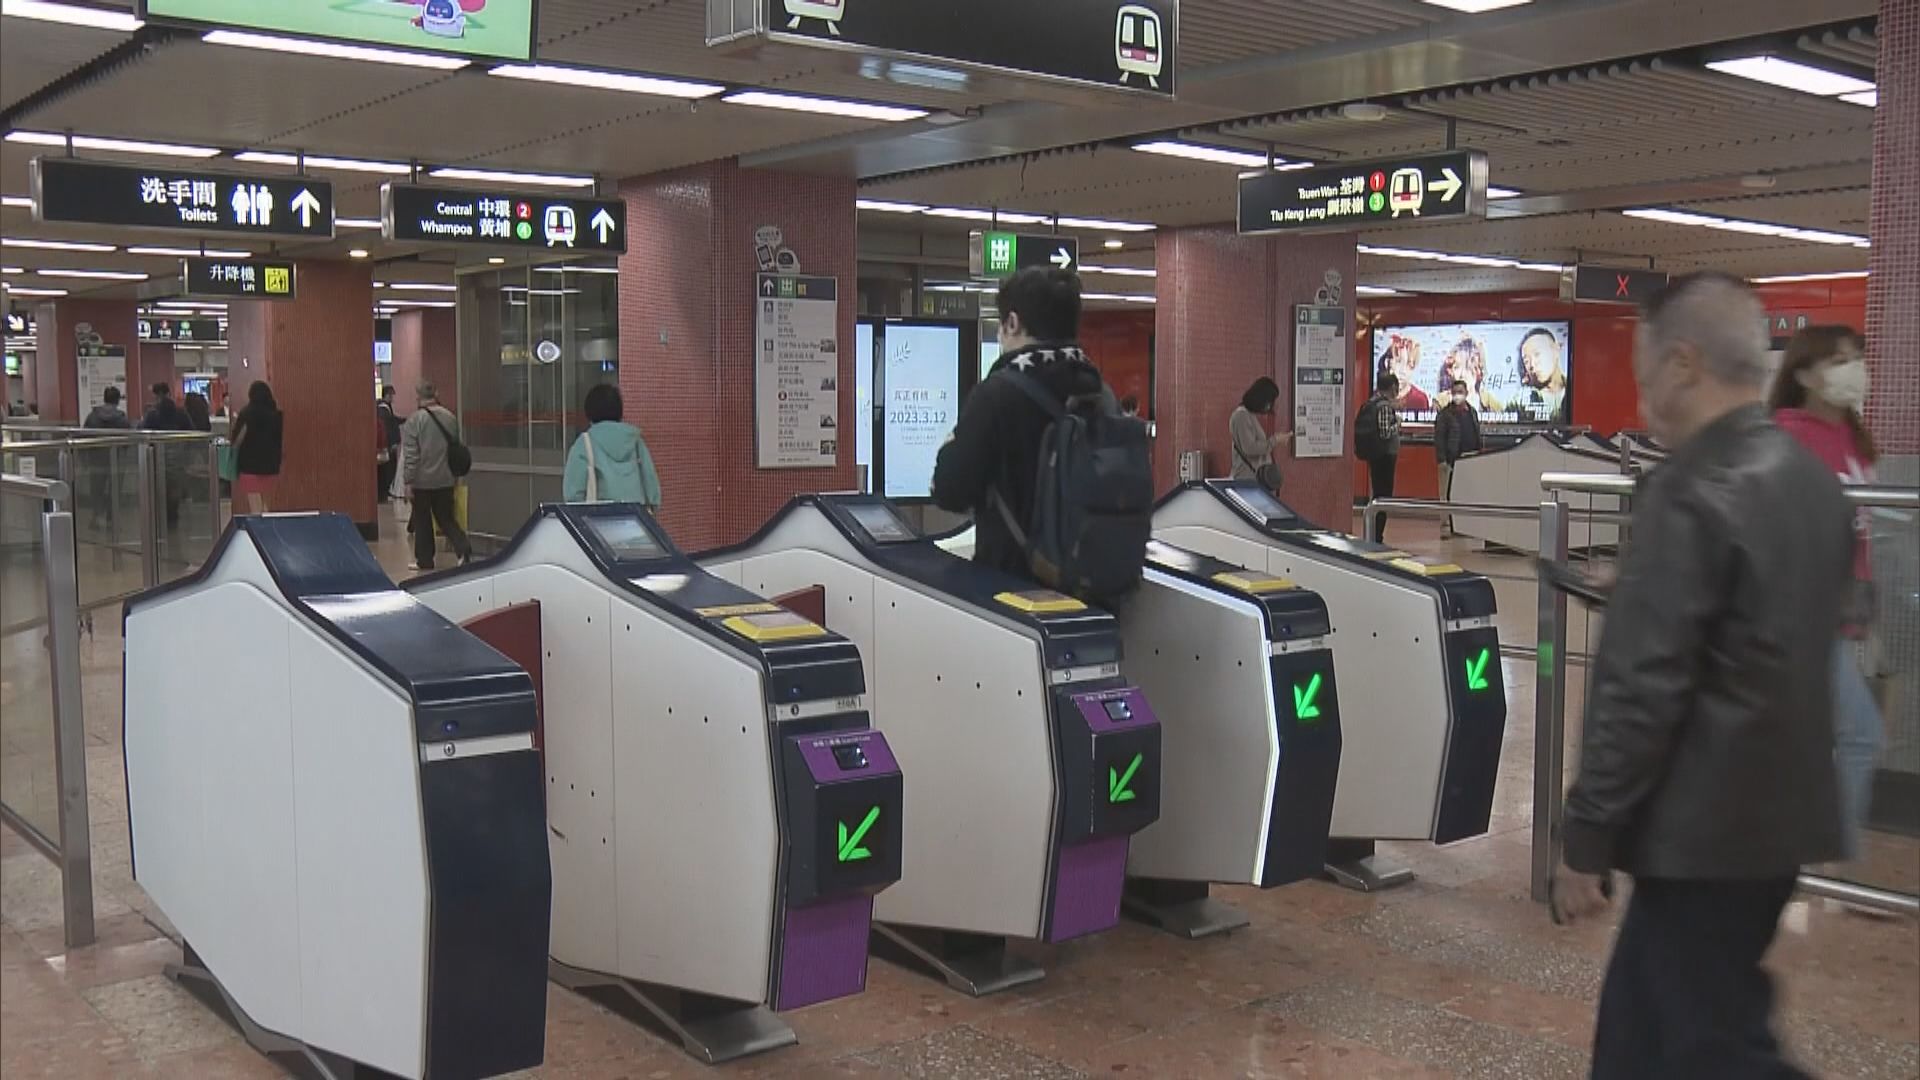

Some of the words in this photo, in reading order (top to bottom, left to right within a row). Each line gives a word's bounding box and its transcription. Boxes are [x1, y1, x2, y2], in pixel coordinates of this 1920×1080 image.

[141, 177, 216, 207] 洗手間
[1298, 188, 1320, 200] Tsuen
[1321, 186, 1338, 198] Wan
[178, 207, 218, 222] Toilets
[436, 202, 472, 217] Central
[478, 198, 510, 217] 中環
[1270, 209, 1284, 221] Tiu
[1285, 209, 1304, 221] Keng
[1305, 207, 1325, 220] Leng
[421, 220, 473, 236] Whampoa
[209, 265, 255, 281] 升降機
[991, 261, 1009, 270] EXIT
[243, 283, 255, 292] Lift
[890, 411, 947, 424] 2023.3.12
